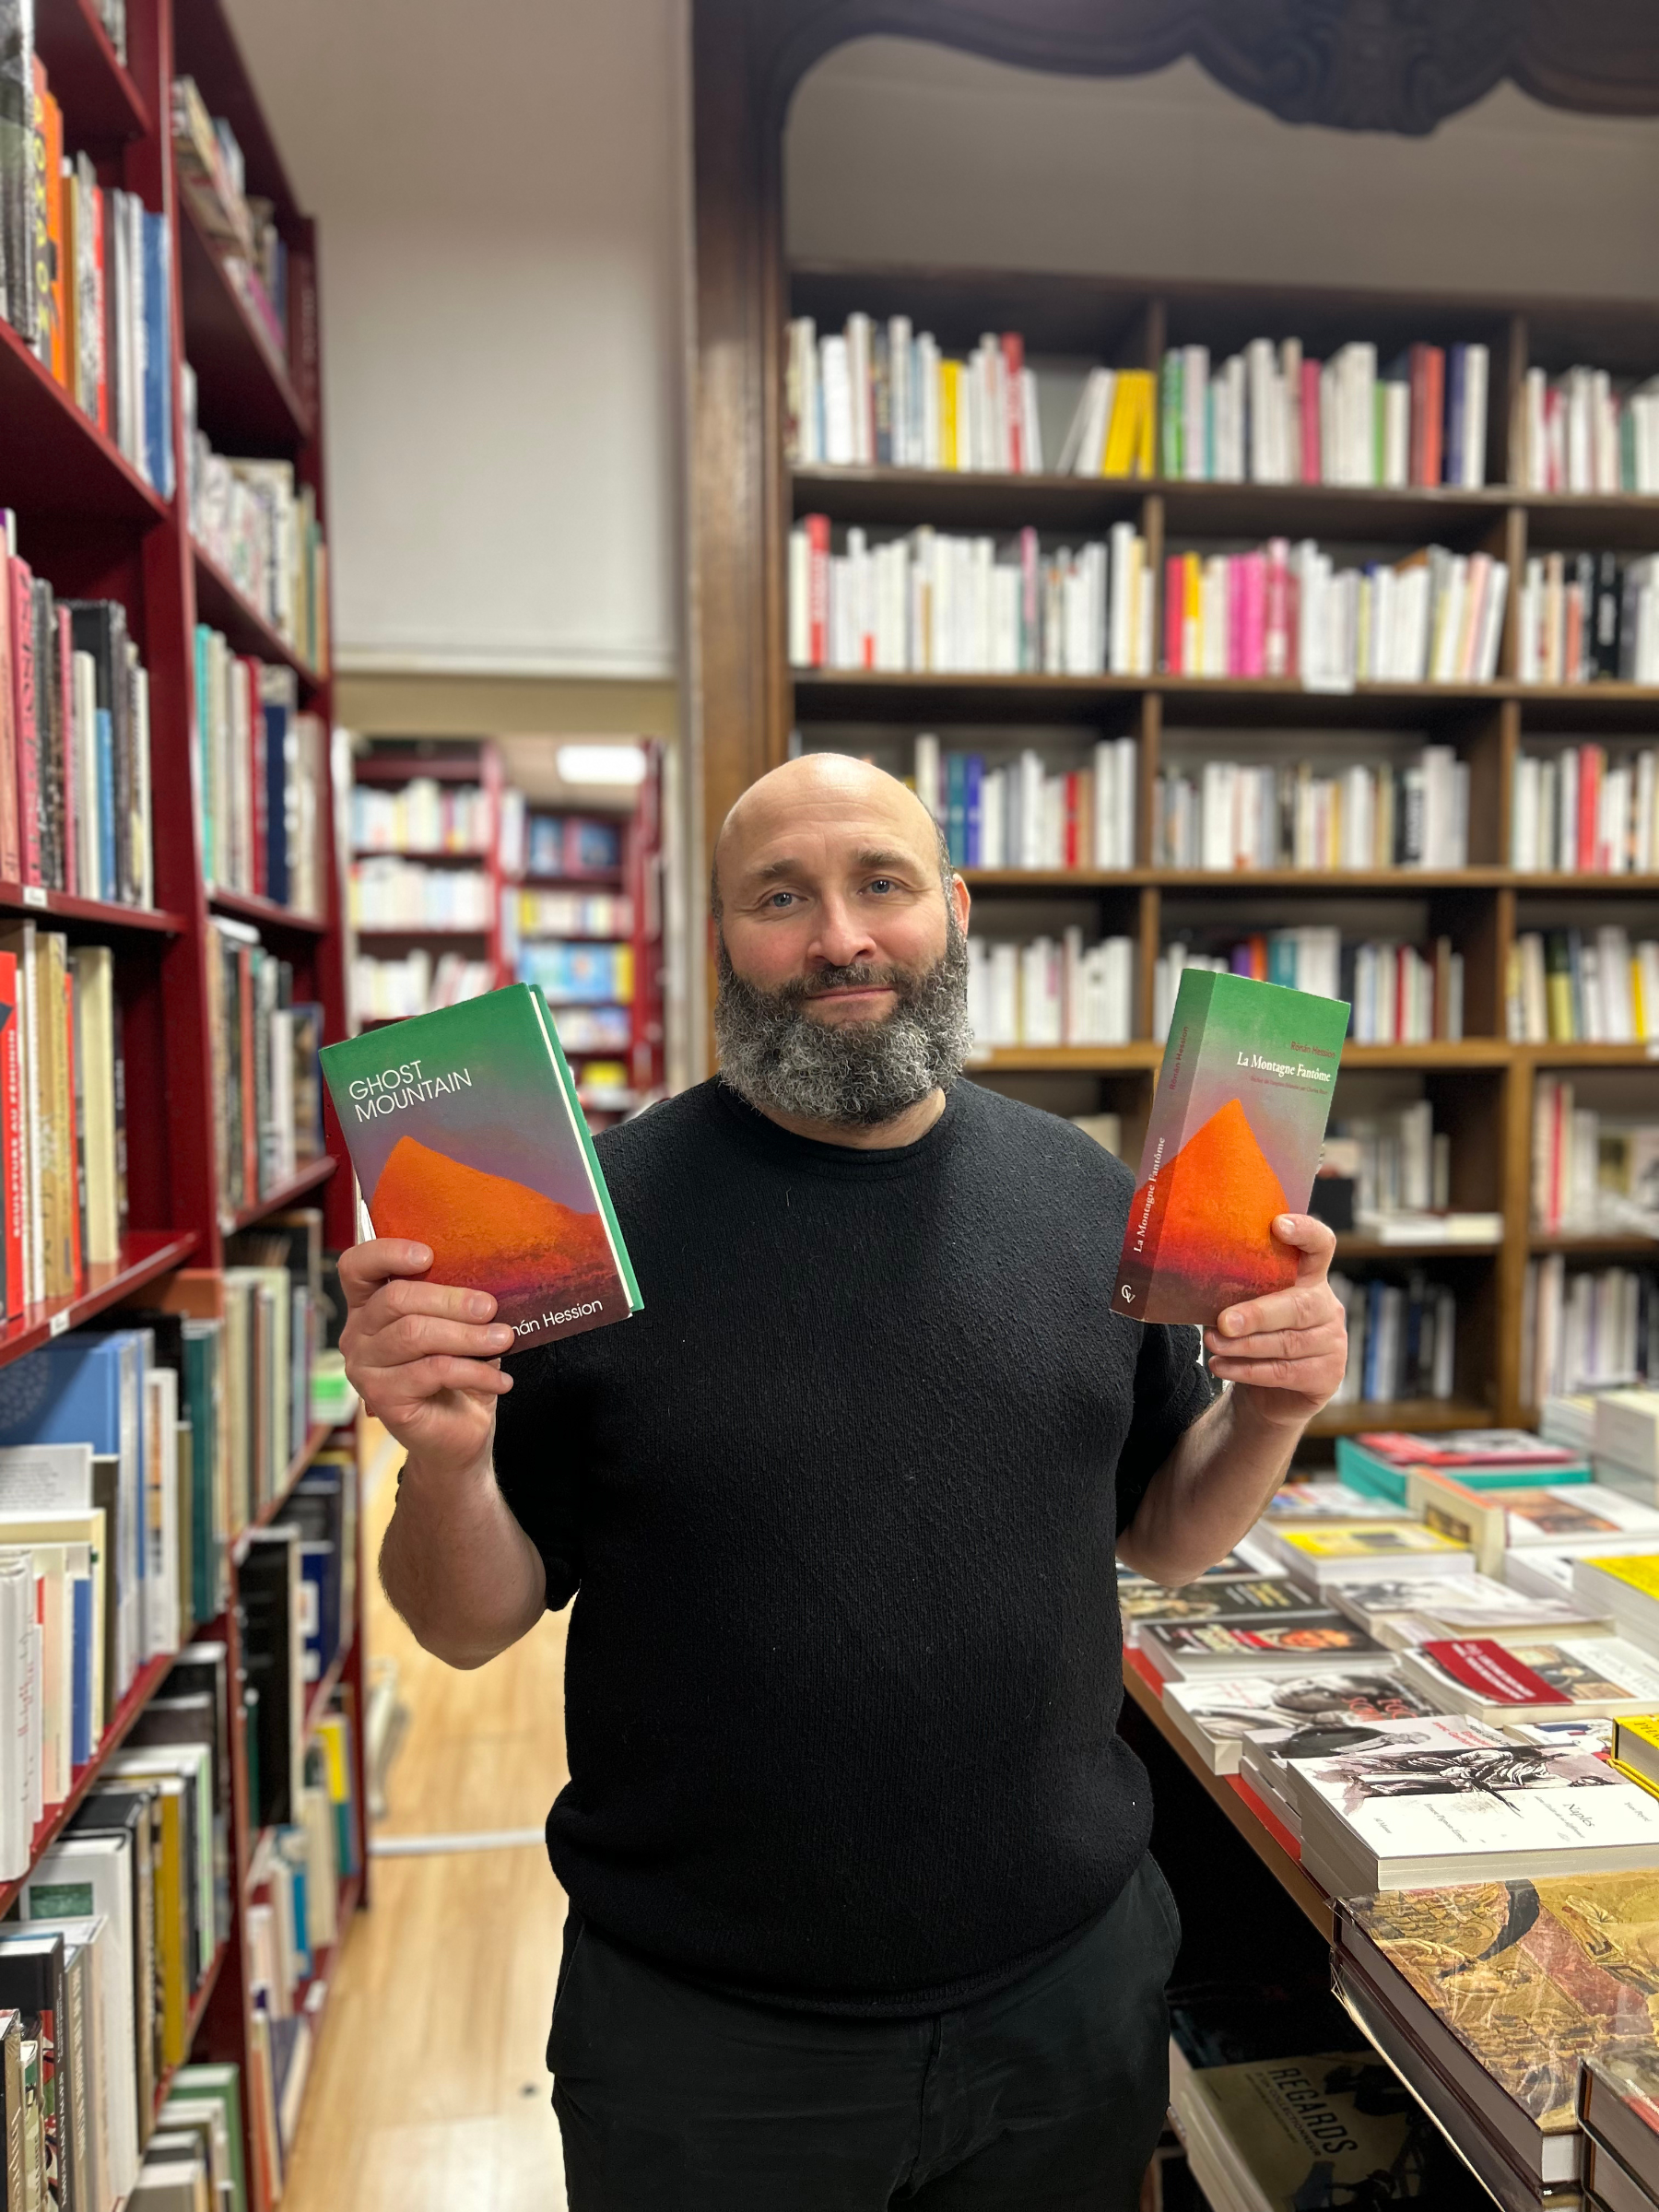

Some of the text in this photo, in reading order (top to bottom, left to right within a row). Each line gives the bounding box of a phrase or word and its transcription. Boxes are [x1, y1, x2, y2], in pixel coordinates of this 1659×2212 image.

[1176, 1027, 1189, 1060] Hession
[1290, 1041, 1335, 1058] Rónán Hession
[348, 1060, 422, 1100] GHOST
[1236, 1052, 1331, 1082] La Montagne Fantôme
[354, 1068, 473, 1123] MOUNTAIN
[1133, 1137, 1166, 1253] La Montagne Fantôme
[512, 1300, 603, 1335] nán Hession
[1562, 1804, 1595, 1828] Naples
[1268, 2067, 1359, 2154] REGARDS
[1269, 2088, 1322, 2157] COLLECTIONNEUR
